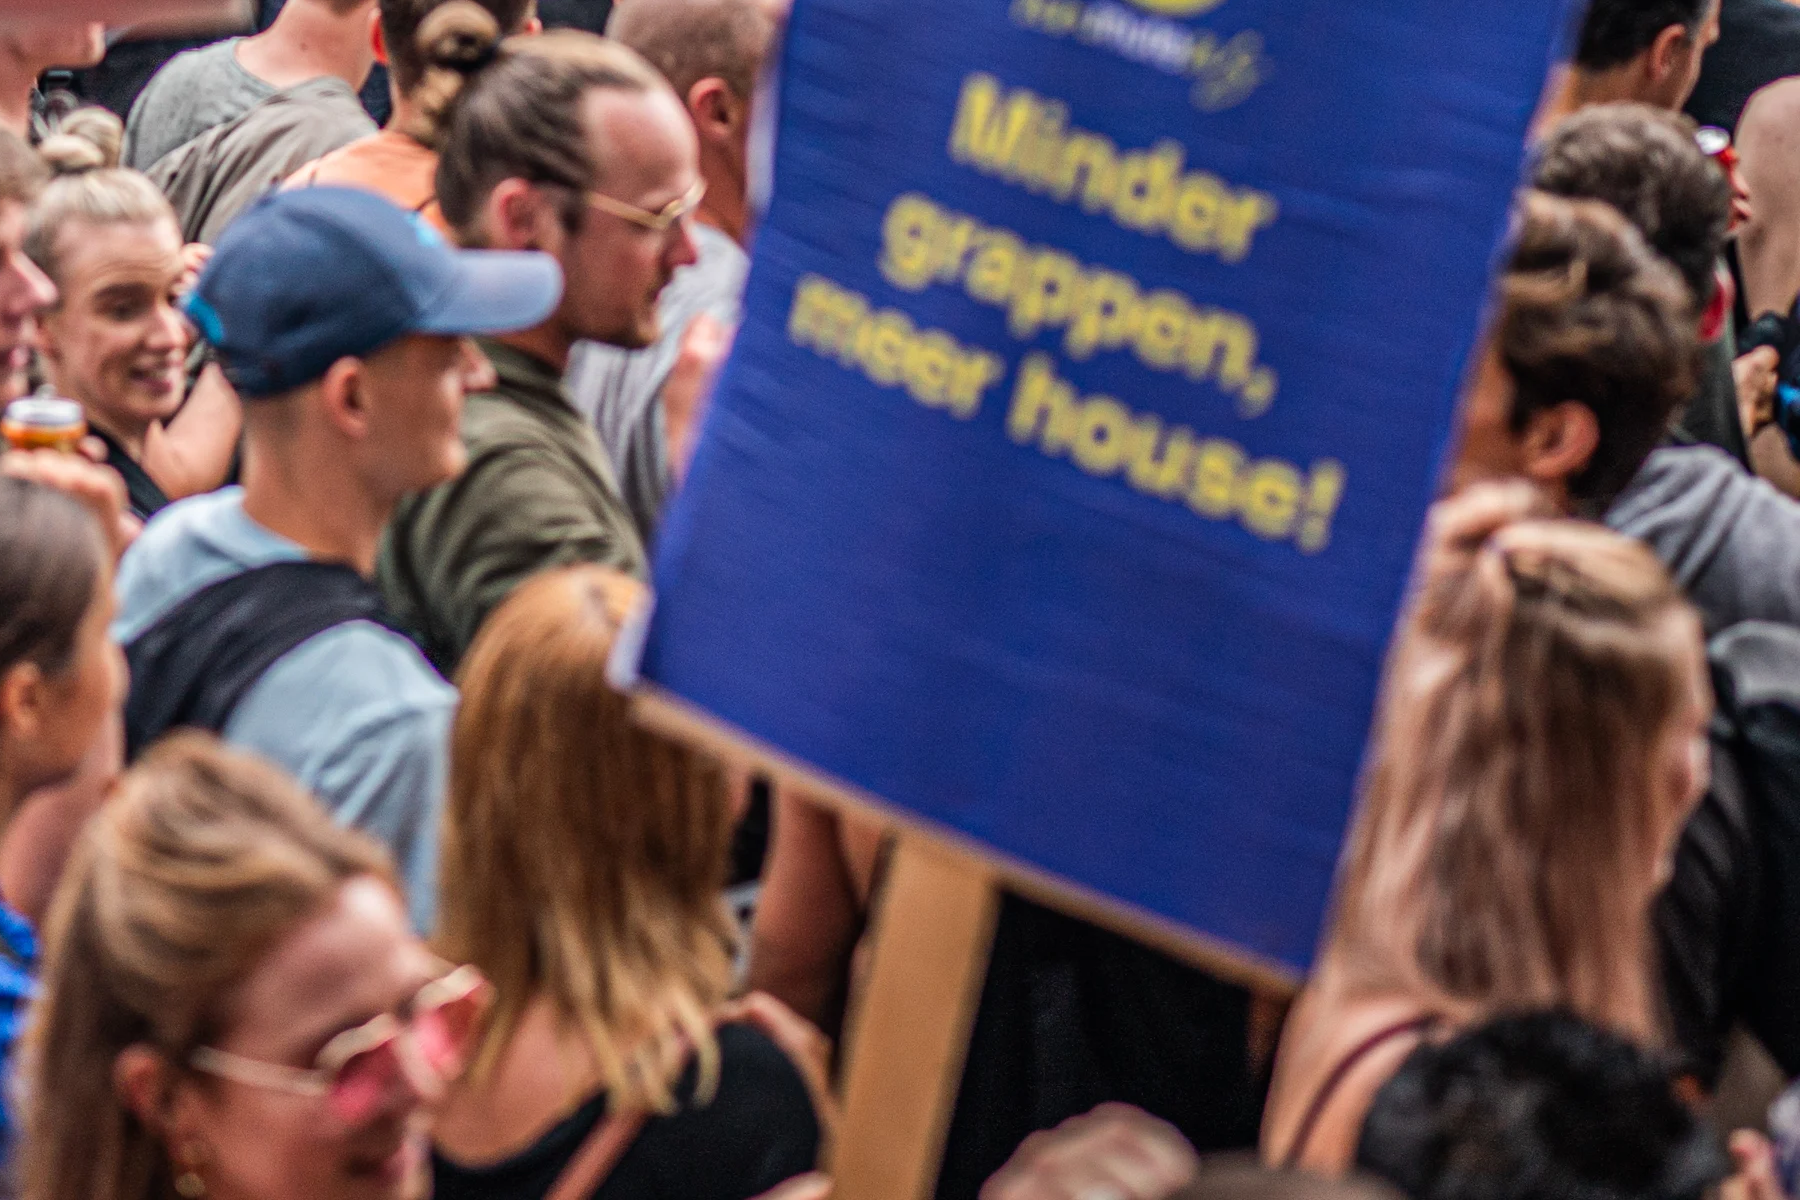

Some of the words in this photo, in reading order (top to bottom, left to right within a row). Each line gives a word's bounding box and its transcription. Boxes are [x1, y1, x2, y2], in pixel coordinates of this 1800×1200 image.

[951, 72, 1277, 262] Minder
[788, 274, 1004, 420] meer
[1008, 351, 1347, 553] house!
[877, 192, 1278, 418] grappen,
